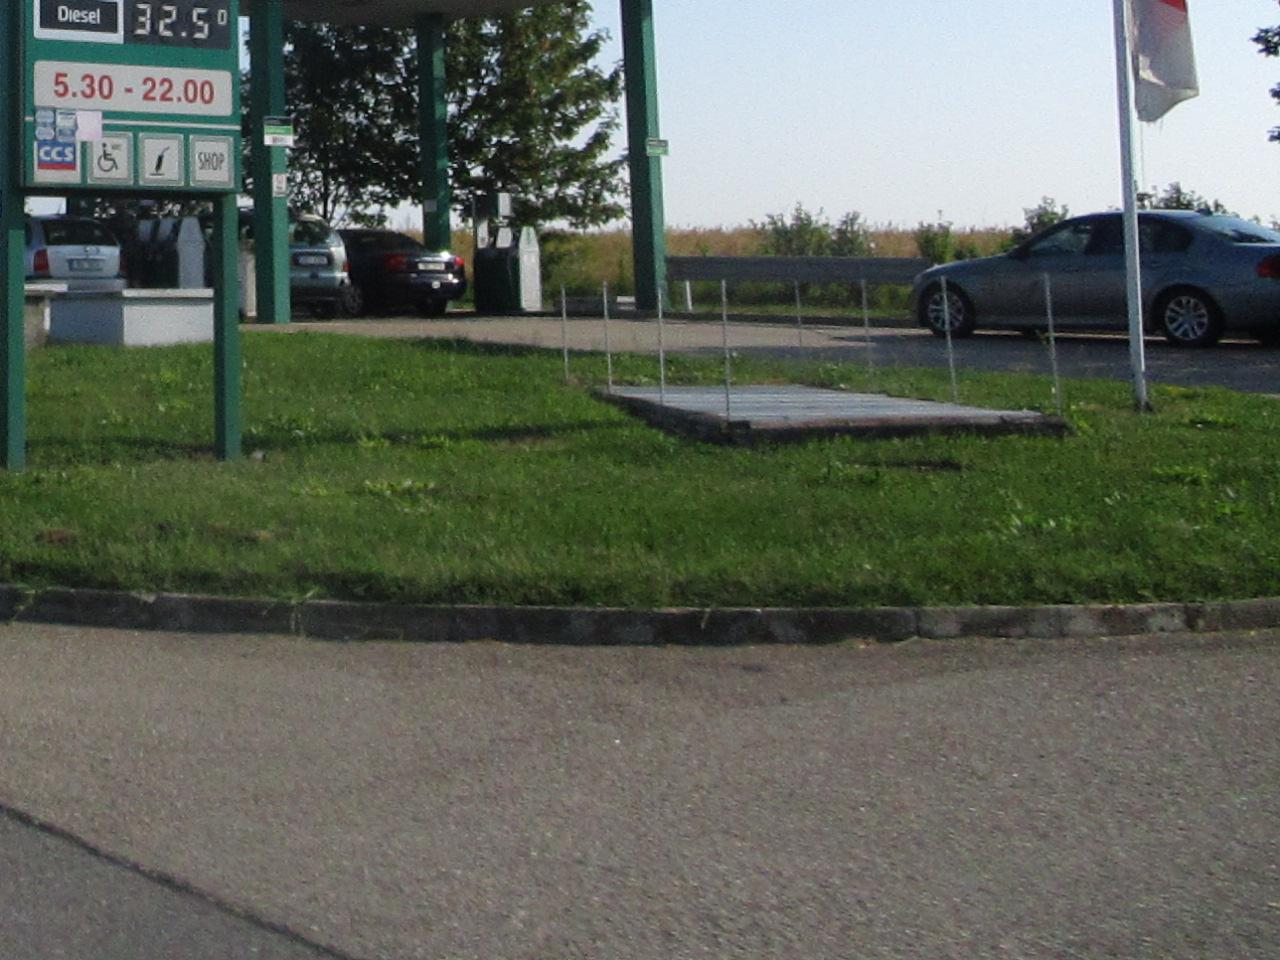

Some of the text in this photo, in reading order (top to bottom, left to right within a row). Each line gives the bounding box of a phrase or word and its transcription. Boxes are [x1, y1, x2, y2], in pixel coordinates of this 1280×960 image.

[57, 5, 101, 25] Diesel
[53, 72, 114, 100] 5.30
[142, 77, 215, 105] 22.00
[39, 146, 75, 163] CCS
[197, 151, 225, 171] SHOP
